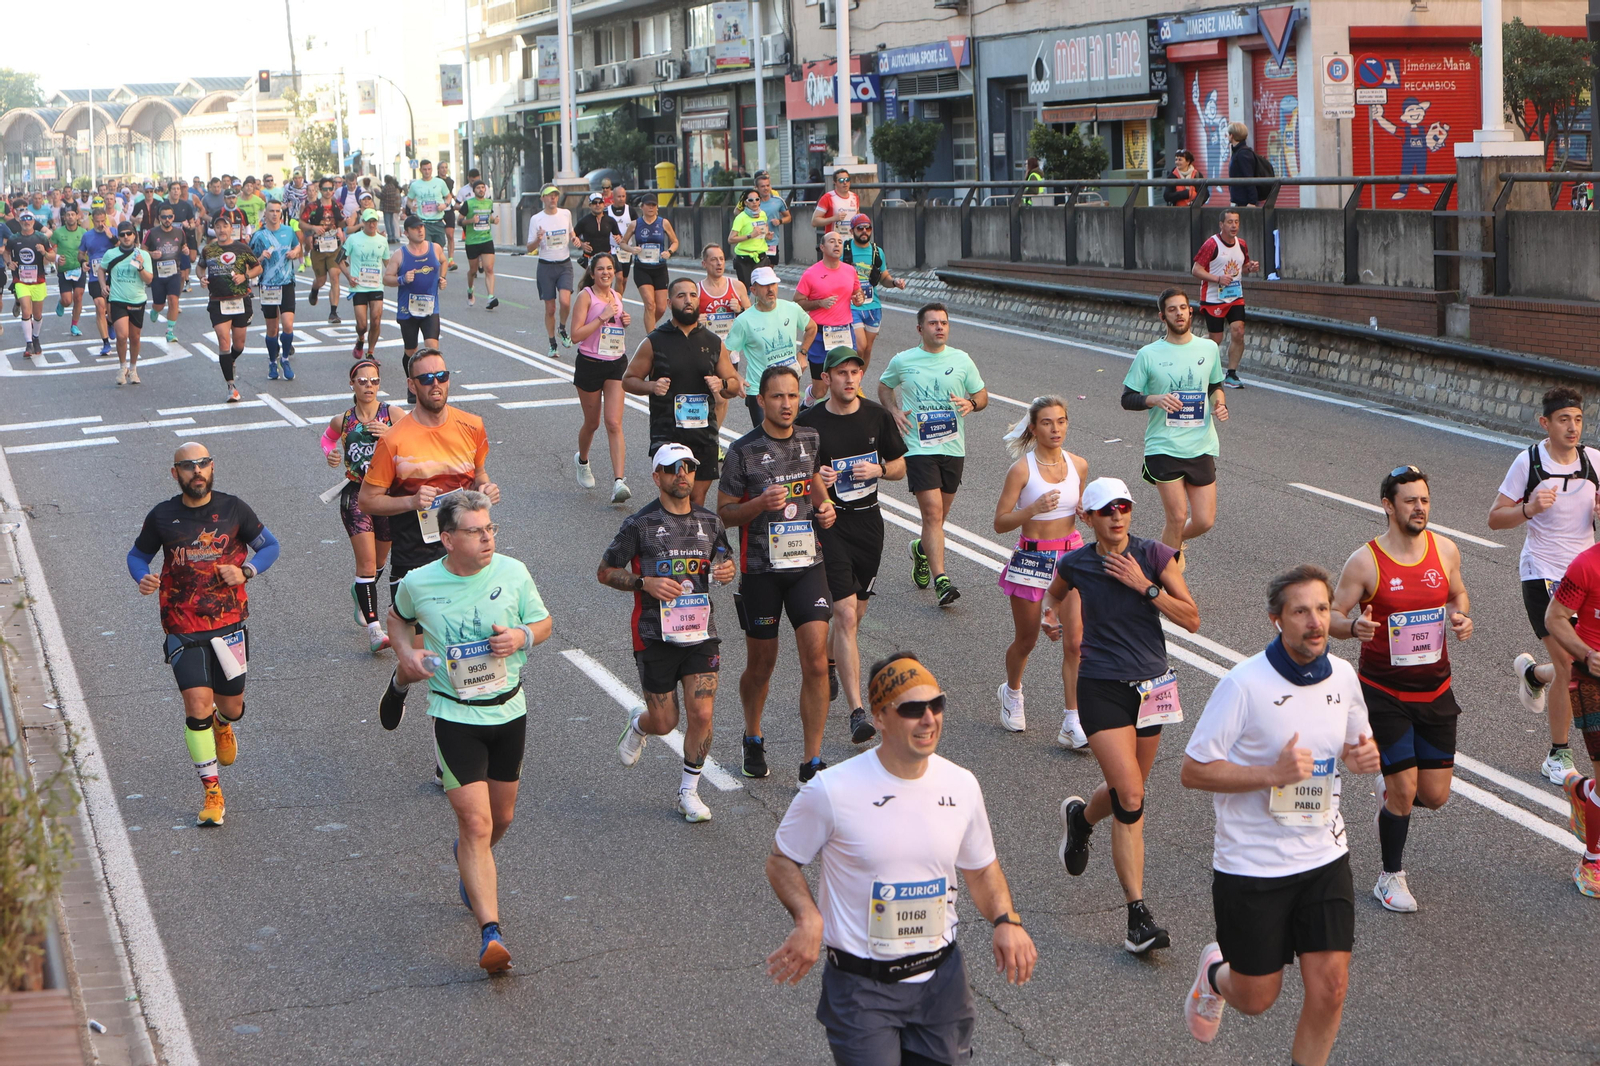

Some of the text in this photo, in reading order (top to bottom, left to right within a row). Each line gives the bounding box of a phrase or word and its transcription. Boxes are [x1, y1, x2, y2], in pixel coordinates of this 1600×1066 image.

[1186, 15, 1216, 36] JIMENEZ
[891, 53, 920, 68] AUTOCLIMA
[1402, 57, 1471, 75] Jiménez Maña
[1404, 80, 1457, 91] RECAMBIOS
[787, 524, 809, 533] ZURICH
[787, 540, 803, 548] 9573
[783, 550, 808, 558] ANDRADE
[680, 597, 705, 606] ZURICH
[1410, 612, 1439, 623] ZURICH
[685, 623, 701, 631] GOMES
[1411, 632, 1429, 642] 7657
[465, 645, 492, 656] ZURIC
[1411, 644, 1431, 653] JAIME
[467, 663, 488, 674] 9936
[463, 672, 496, 686] FRANCOIS
[1294, 785, 1323, 796] 10169
[1294, 801, 1321, 810] PABLO
[899, 883, 940, 897] ZURICH
[896, 910, 927, 921] 10168
[898, 926, 923, 936] BRAM
